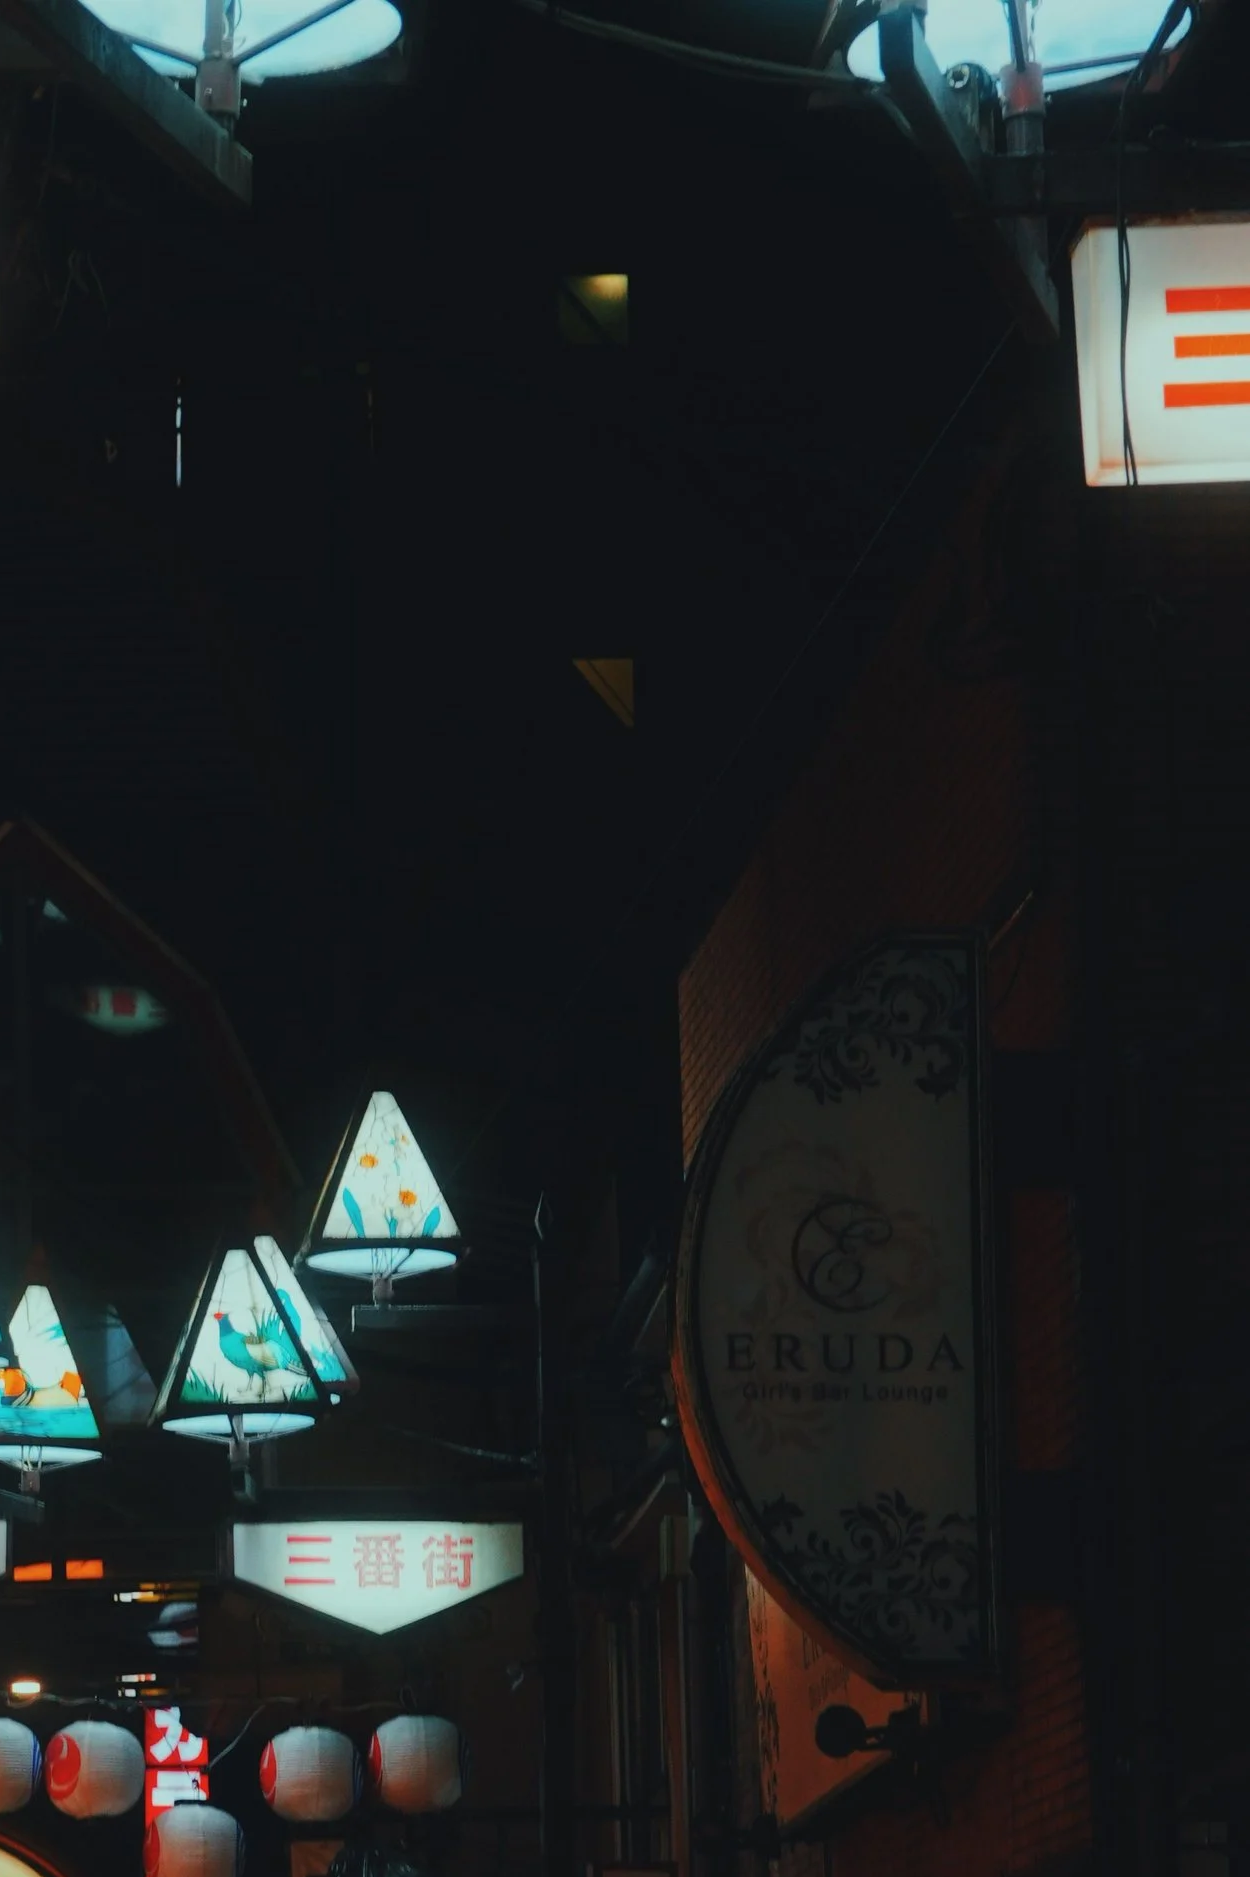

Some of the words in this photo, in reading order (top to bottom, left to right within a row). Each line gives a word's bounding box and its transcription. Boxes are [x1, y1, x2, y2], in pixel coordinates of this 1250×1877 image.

[726, 1332, 964, 1376] ERUDA
[283, 1533, 475, 1590] 三番街
